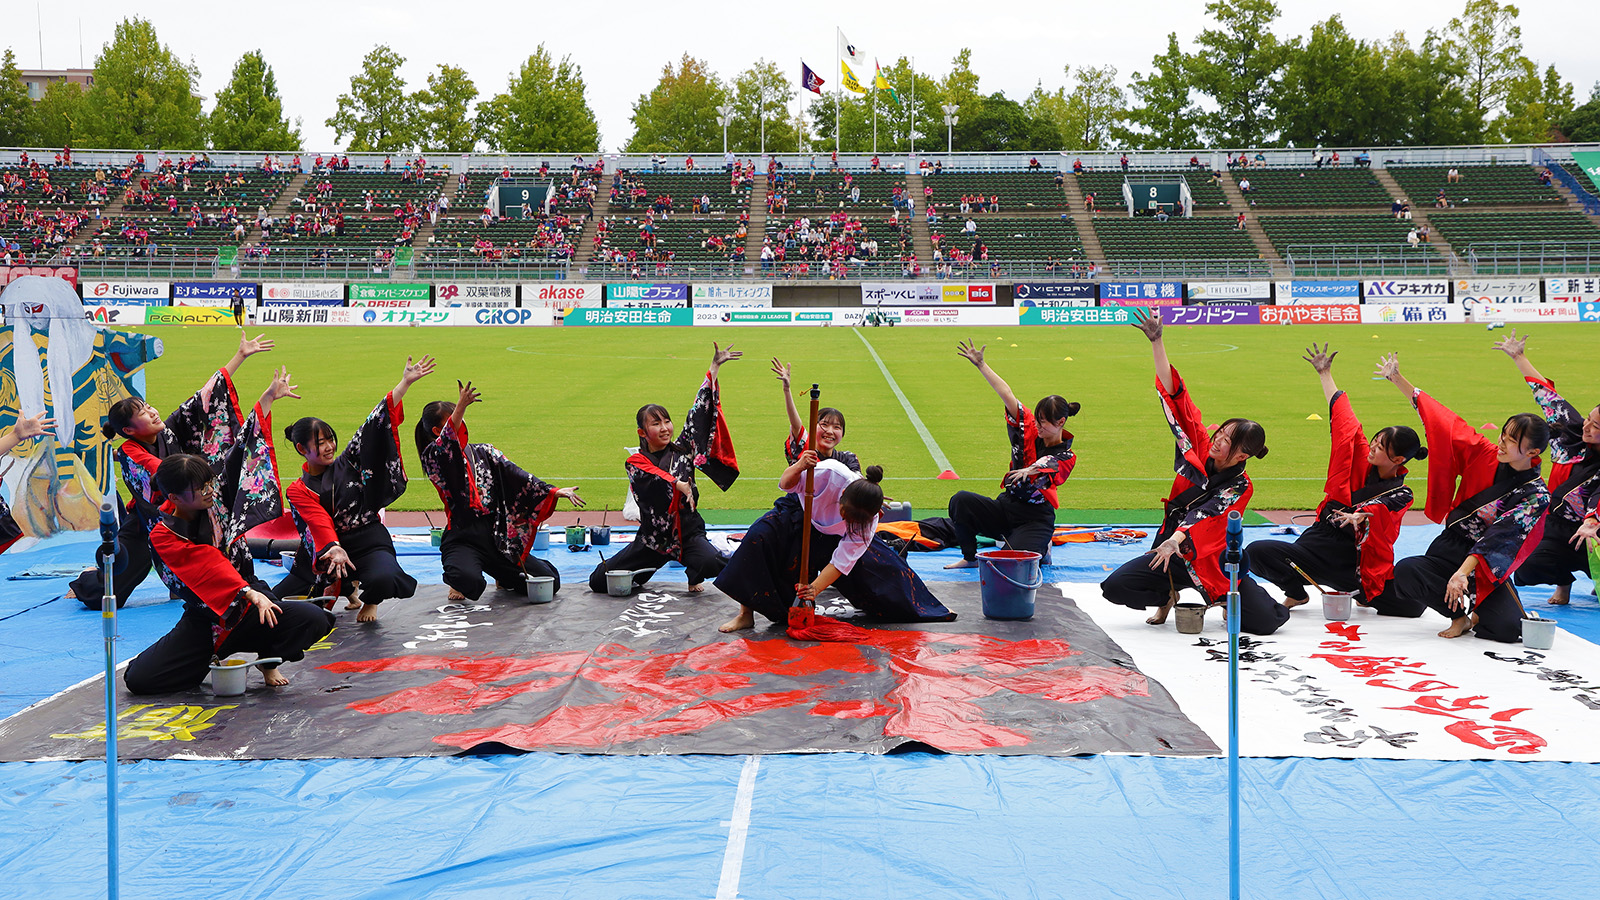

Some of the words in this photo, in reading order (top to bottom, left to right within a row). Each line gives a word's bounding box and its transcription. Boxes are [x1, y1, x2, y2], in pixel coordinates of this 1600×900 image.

[522, 189, 529, 200] 9
[1150, 187, 1157, 198] 8
[113, 285, 158, 297] Fujiwara
[466, 286, 512, 298] 双葉電機
[613, 286, 681, 298] 山陽セフティ
[708, 286, 771, 298] 旭ホールディングス
[1107, 284, 1176, 298] 江口電機
[1292, 285, 1358, 293] エイブルスポーツクラブ
[1397, 284, 1446, 295] アキオカ
[1568, 279, 1600, 293] 新生
[539, 285, 584, 300] akase
[865, 288, 915, 300] スポーツくじ
[263, 309, 328, 323] 山陽新聞
[381, 310, 450, 323] オカネツ
[585, 310, 672, 323] 明治安田生命
[1041, 309, 1129, 322] 明治安田生命
[1171, 307, 1248, 323] アン・ドゥー
[1262, 307, 1359, 322] おかやま信金
[1402, 306, 1447, 322] 備商
[1558, 308, 1577, 316] 岡山
[149, 315, 221, 323] PENALTY
